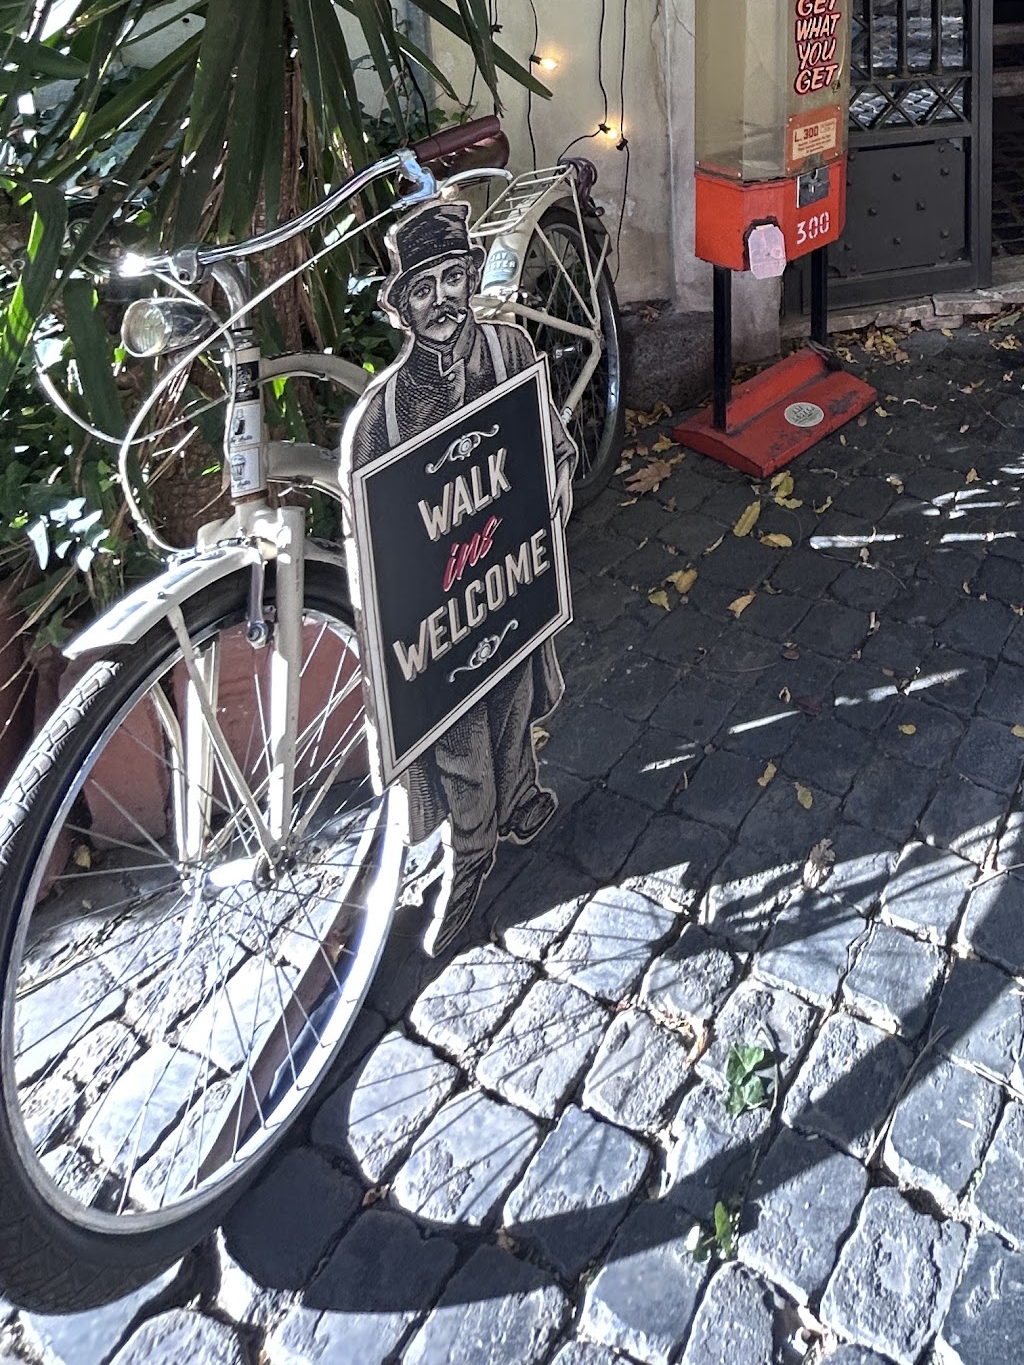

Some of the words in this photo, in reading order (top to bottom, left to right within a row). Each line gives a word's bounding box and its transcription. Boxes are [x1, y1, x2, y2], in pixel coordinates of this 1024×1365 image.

[796, 13, 840, 42] WHAT
[799, 38, 836, 69] YOU
[795, 65, 838, 94] GET
[804, 126, 818, 140] 300
[796, 211, 829, 245] 300
[490, 251, 509, 263] JAY
[418, 447, 511, 542] WALK
[442, 515, 503, 592] ins
[392, 528, 551, 681] WELCOME
